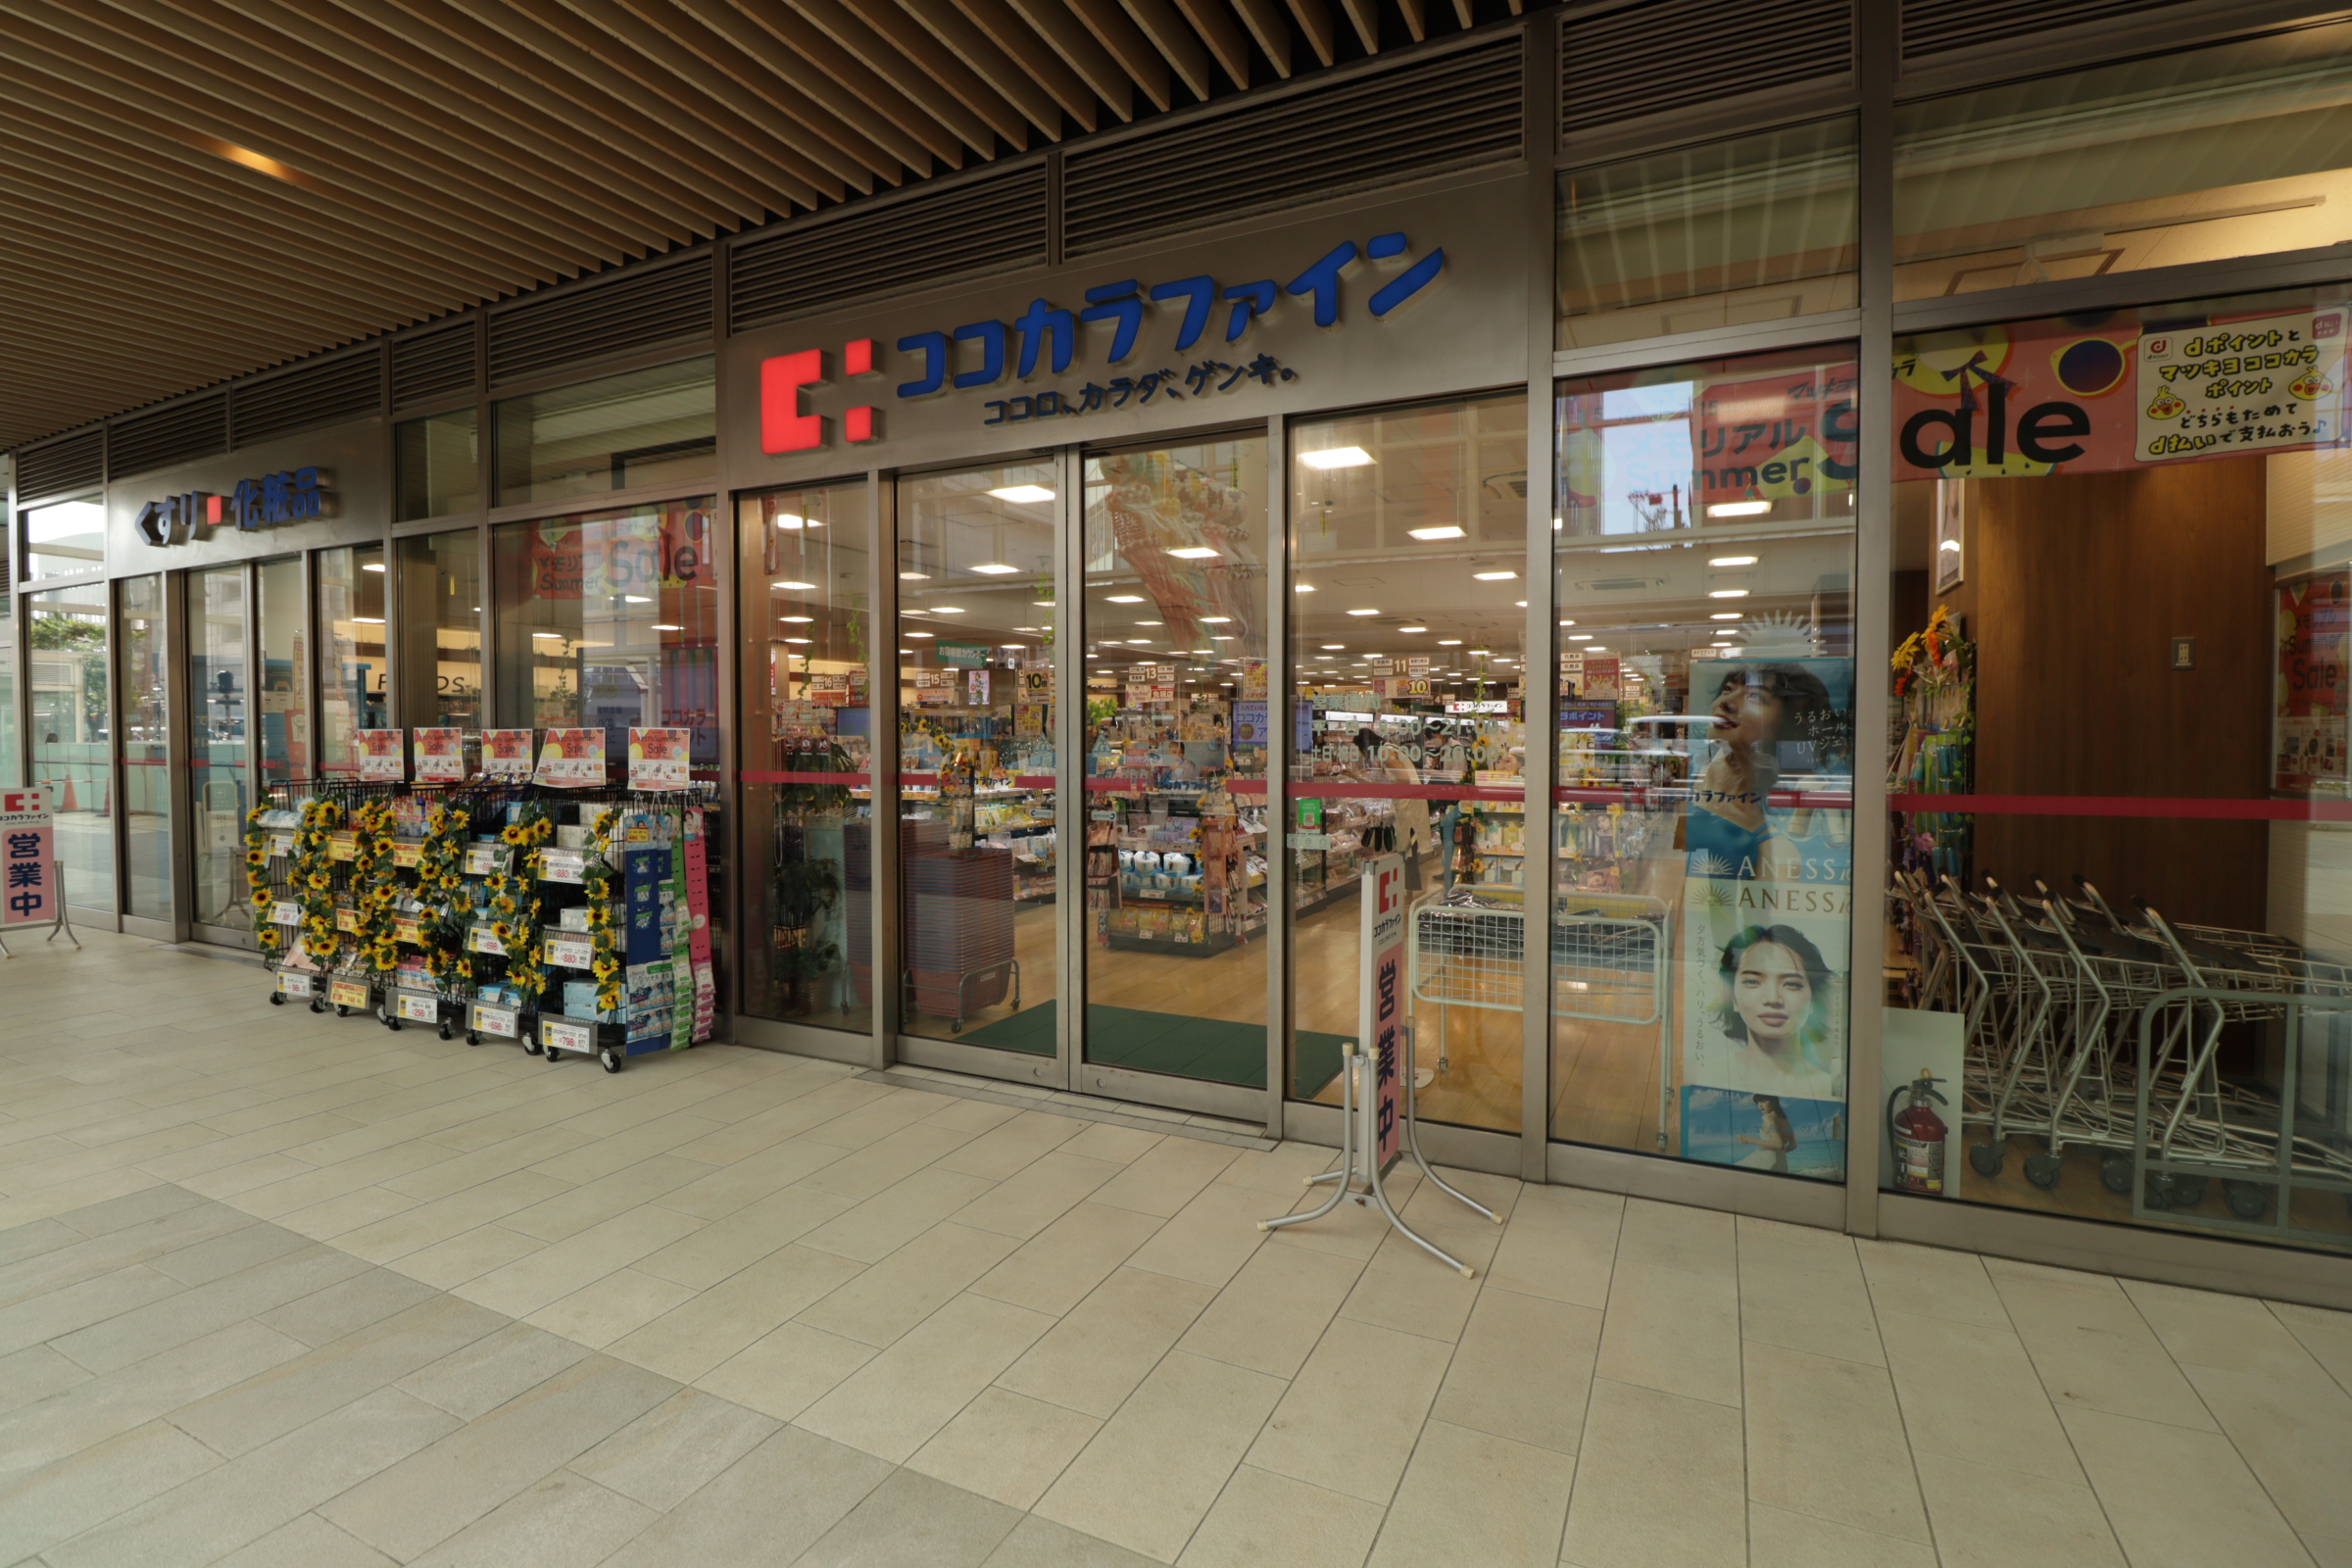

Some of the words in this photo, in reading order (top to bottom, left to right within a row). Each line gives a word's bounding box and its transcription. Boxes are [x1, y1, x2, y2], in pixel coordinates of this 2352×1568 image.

[897, 231, 1444, 398] ココカラファイン
[2184, 330, 2300, 357] dポイントと
[2159, 346, 2320, 382] マツキヨココカラ
[984, 354, 1294, 424] ココロ、カラダ、ゲンキ。
[2205, 377, 2273, 399] ポイント
[2180, 403, 2297, 428] どちらもためて
[134, 491, 197, 545] くすり
[229, 466, 321, 531] 化粧品
[605, 530, 699, 588] Sale
[1145, 667, 1156, 679] 13
[1395, 660, 1407, 673] 11
[2293, 657, 2337, 691] Sale
[378, 673, 466, 693] FDS
[823, 676, 833, 688] 16
[930, 673, 940, 685] 15
[1312, 693, 1381, 710] 営業時間
[427, 741, 444, 752] Sale
[498, 744, 515, 754] Sale
[566, 743, 583, 754] Sale
[648, 743, 667, 755] Sale
[8, 833, 42, 917] 営業中
[563, 1036, 574, 1048] 798
[1379, 958, 1396, 1152] 営業中
[1706, 1089, 1741, 1101] ANESSA
